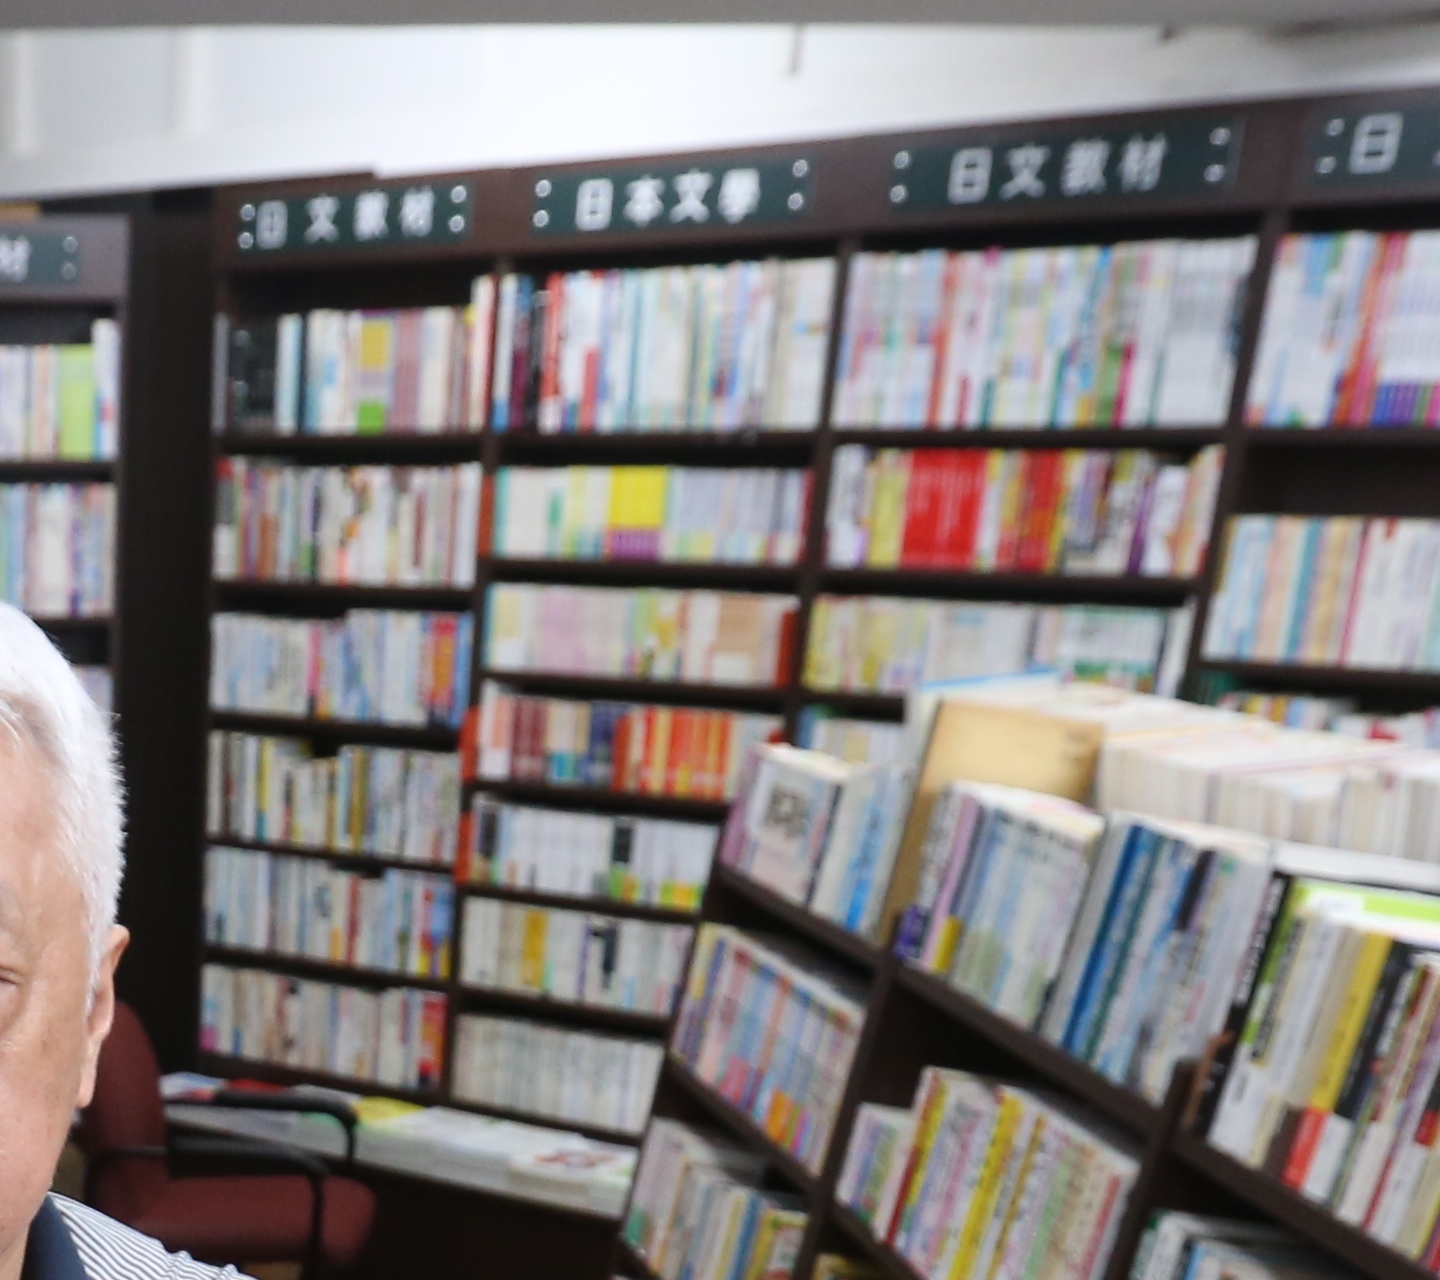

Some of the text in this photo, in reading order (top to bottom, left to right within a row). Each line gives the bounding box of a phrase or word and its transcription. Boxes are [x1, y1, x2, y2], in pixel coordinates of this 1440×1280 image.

[576, 167, 762, 232] 日本文學
[950, 133, 1168, 203] 日文教材
[258, 183, 436, 249] 日文教材
